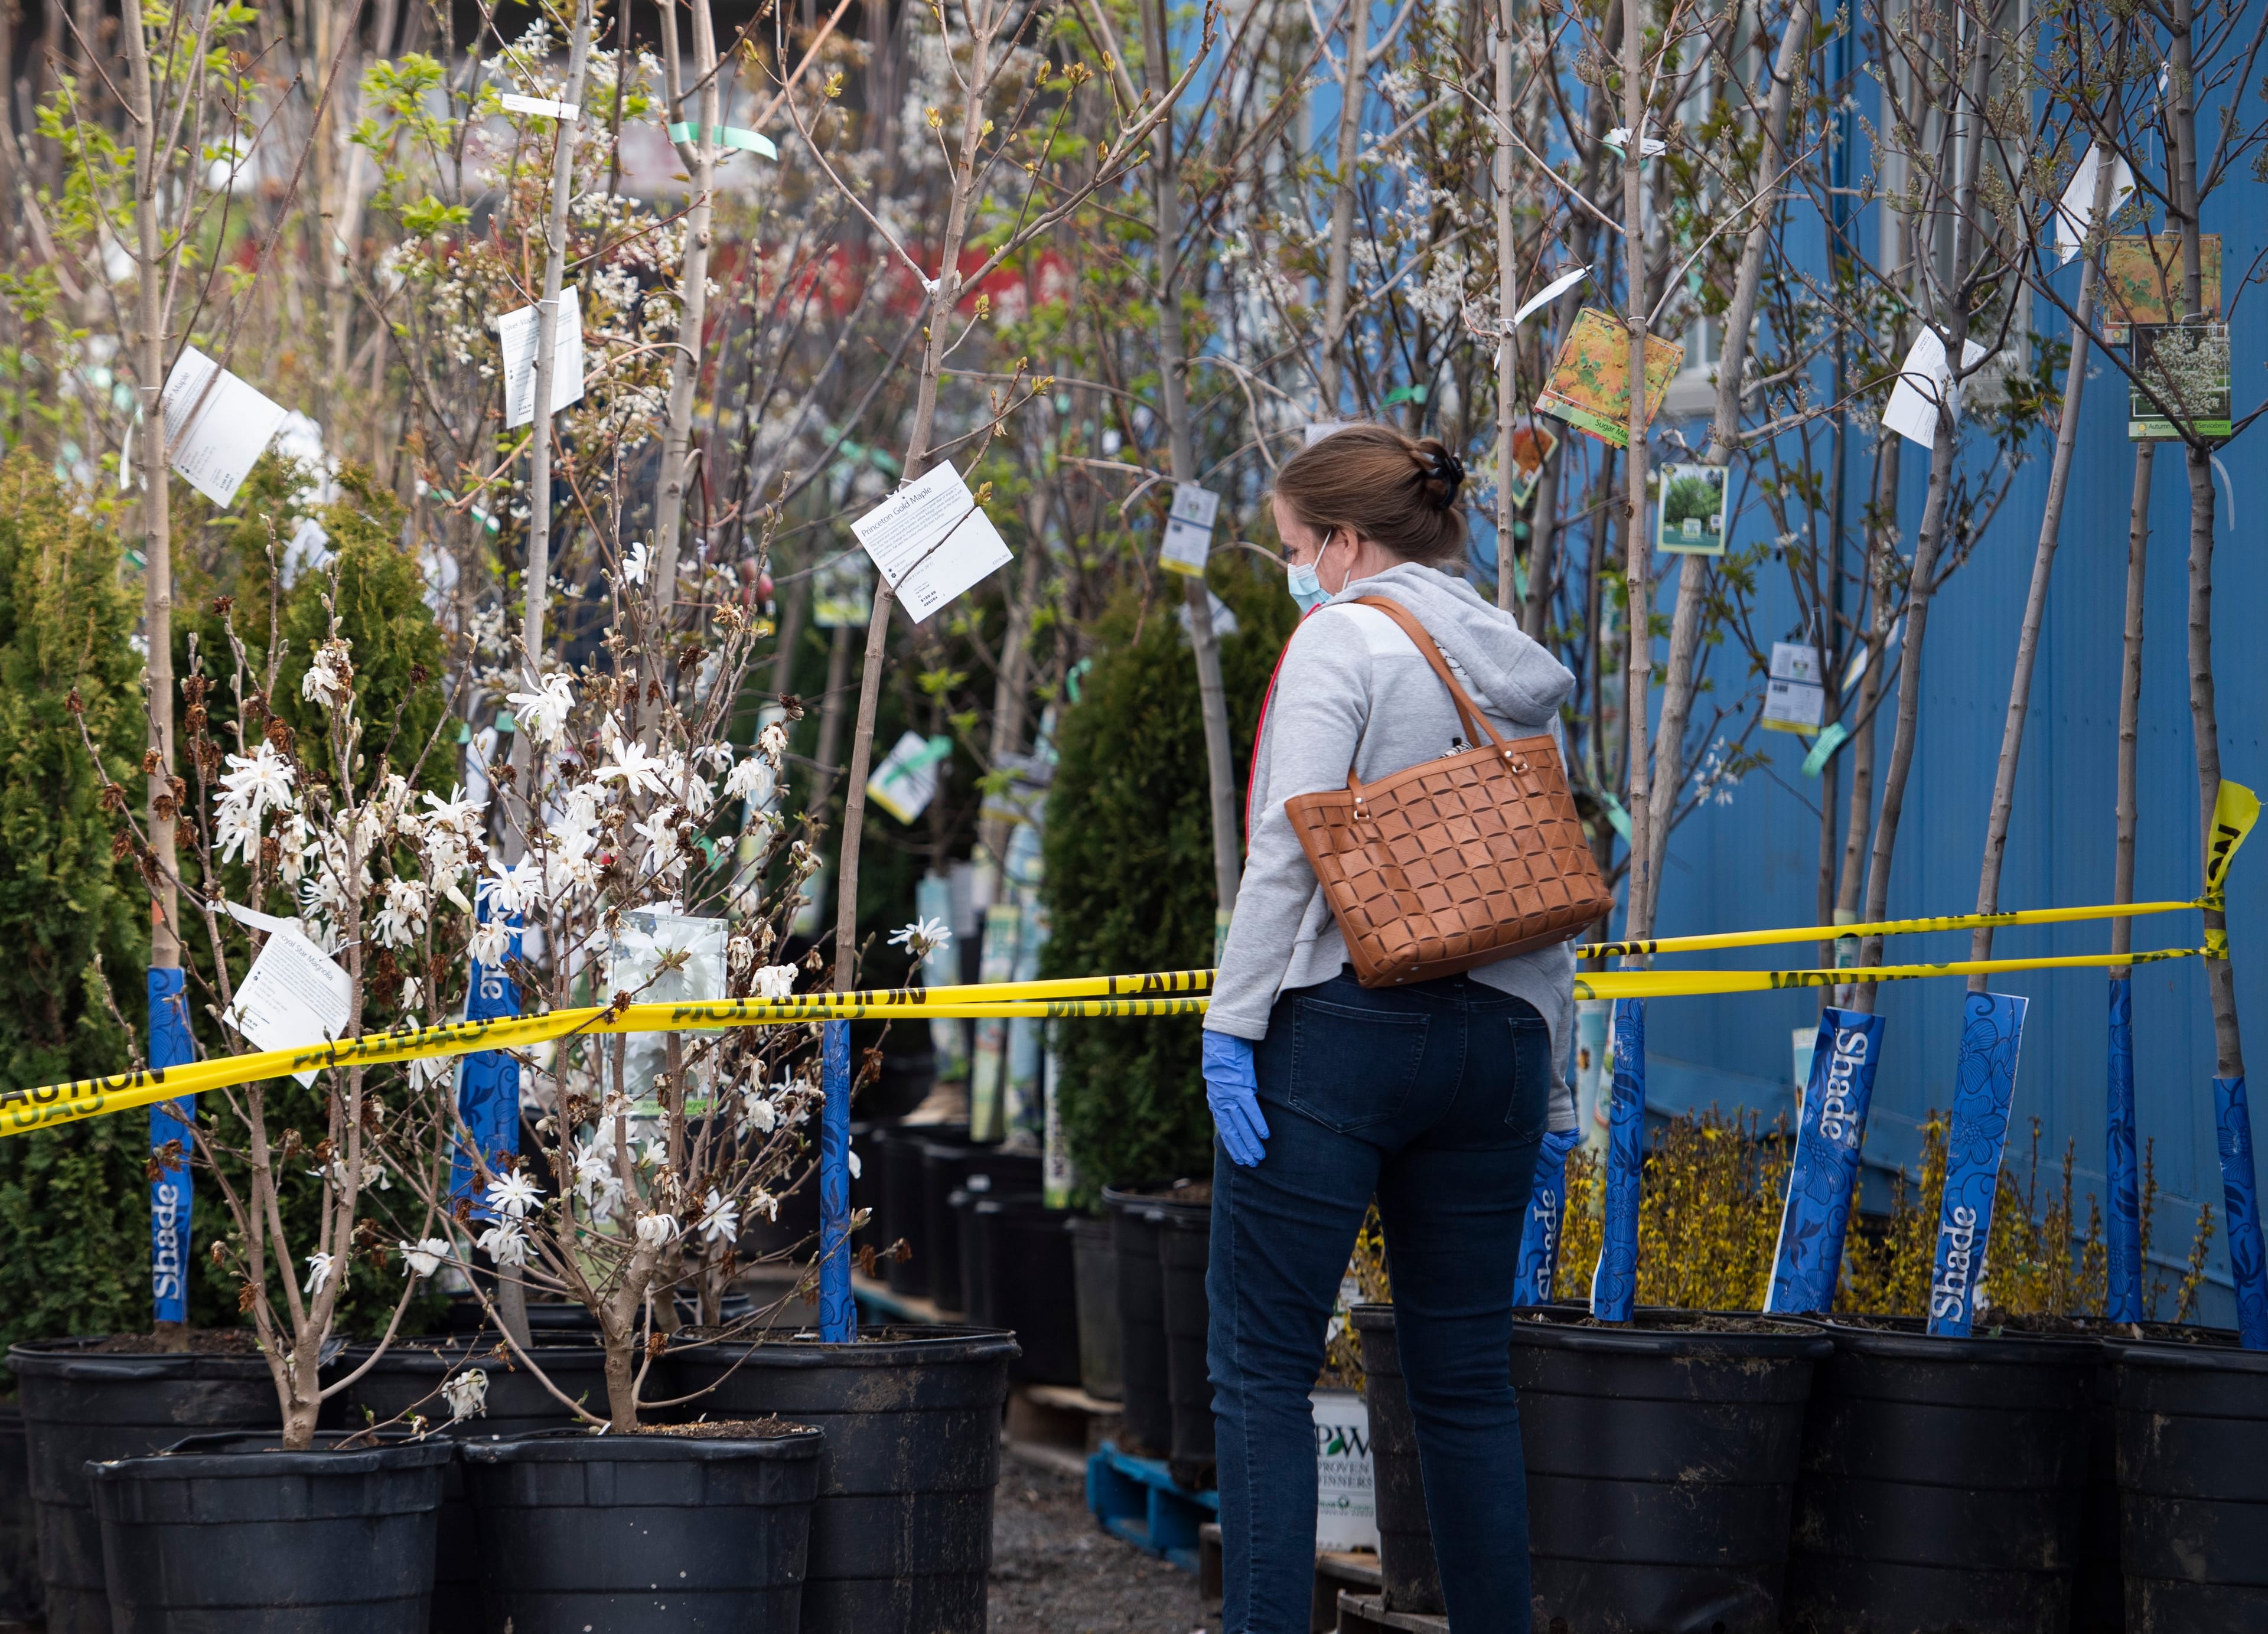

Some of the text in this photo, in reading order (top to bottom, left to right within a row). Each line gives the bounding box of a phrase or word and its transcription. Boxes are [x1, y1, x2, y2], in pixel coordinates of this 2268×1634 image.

[171, 370, 191, 395] Maple
[1595, 419, 1615, 432] Sugar
[861, 513, 893, 537] Princeton
[892, 500, 911, 516] Gold
[909, 487, 932, 504] Maple
[295, 945, 307, 958] Star
[307, 955, 334, 981] Magnolia
[1820, 1028, 1868, 1140] Shade
[152, 1183, 180, 1300] Shade
[1932, 1206, 1977, 1322] Shade
[1319, 1474, 1373, 1488] INNERS
